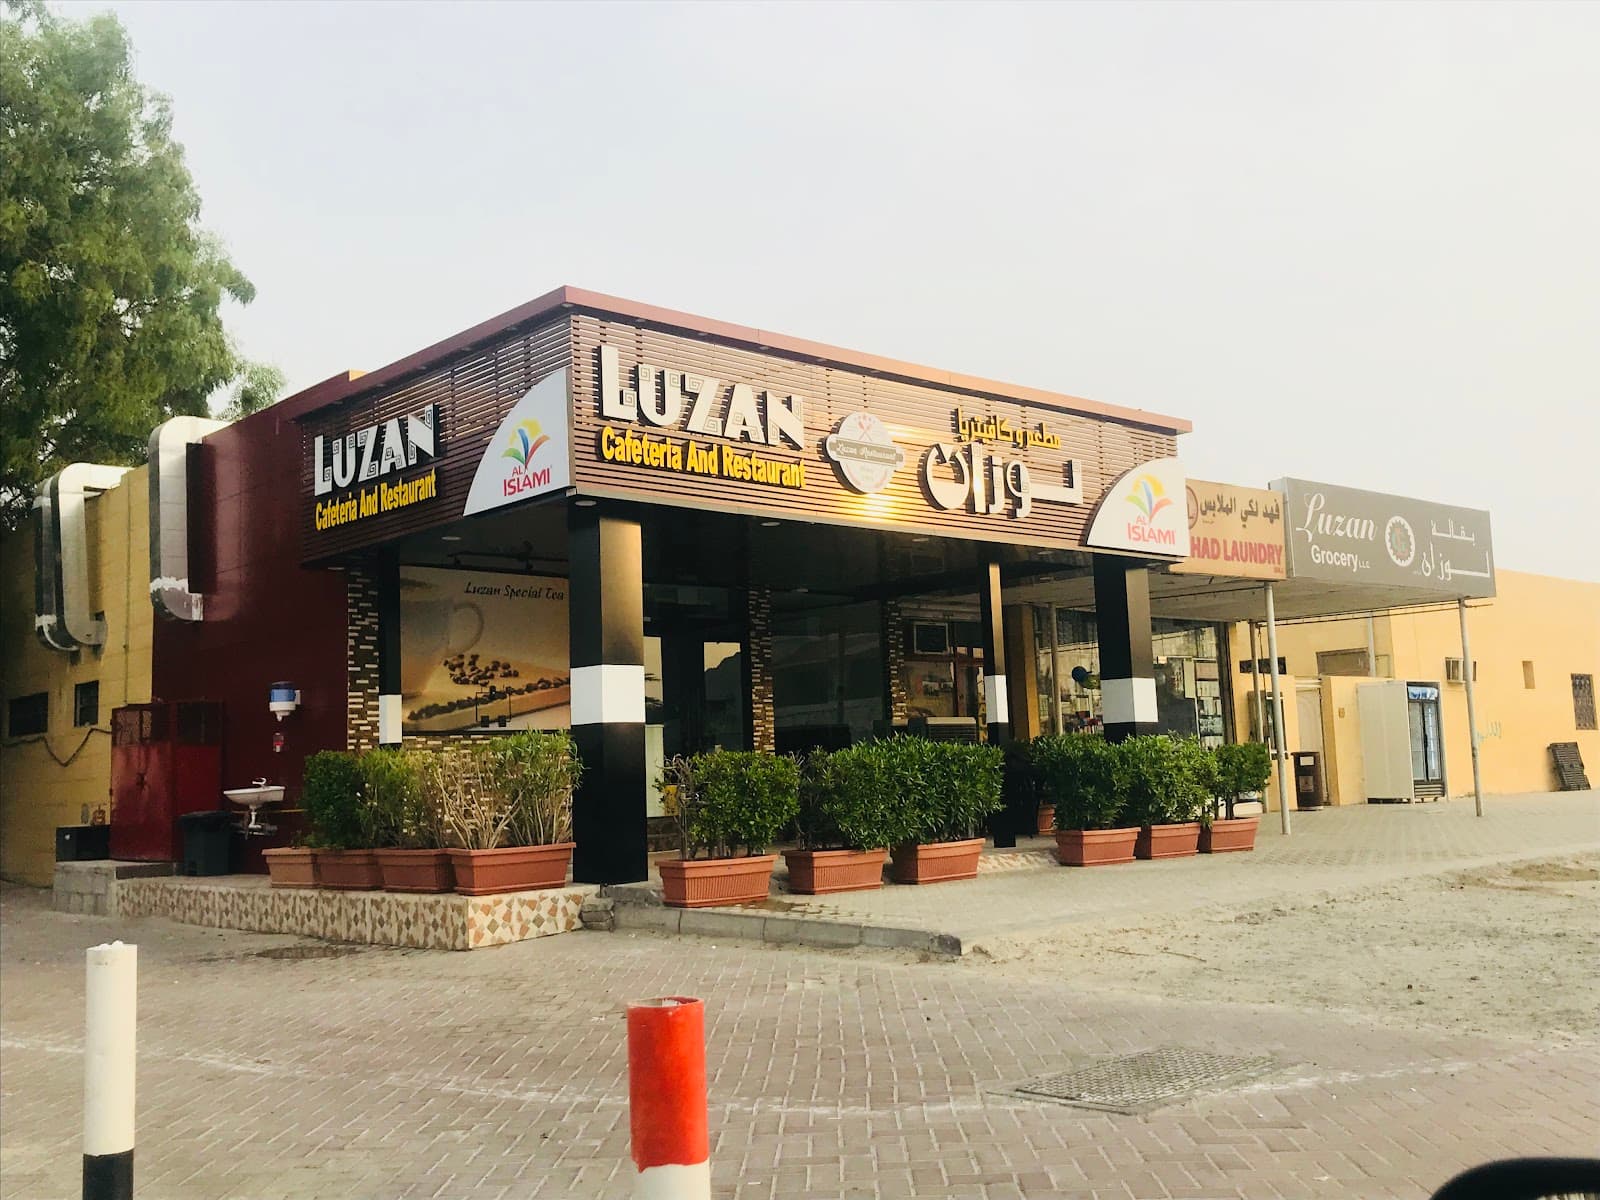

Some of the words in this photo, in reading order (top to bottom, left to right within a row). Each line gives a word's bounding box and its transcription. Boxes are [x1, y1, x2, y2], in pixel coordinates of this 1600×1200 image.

[600, 344, 805, 449] LUZAN
[314, 403, 435, 496] LUZAN
[601, 426, 682, 470] Cafeteria
[686, 440, 718, 475] And
[722, 445, 806, 488] Restaurant
[503, 467, 550, 496] ISLAMI
[512, 465, 523, 477] AL
[315, 491, 358, 531] Cafeteria
[360, 485, 378, 518] And
[380, 466, 437, 512] Restaurant
[1135, 515, 1147, 525] AL
[1296, 493, 1379, 543] Luzan
[1127, 522, 1176, 545] ISLAMI
[1223, 539, 1283, 565] LAUNDRY
[1311, 544, 1358, 572] Grocery
[464, 582, 500, 596] Luzan
[504, 584, 542, 600] Special
[545, 587, 564, 600] Tea
